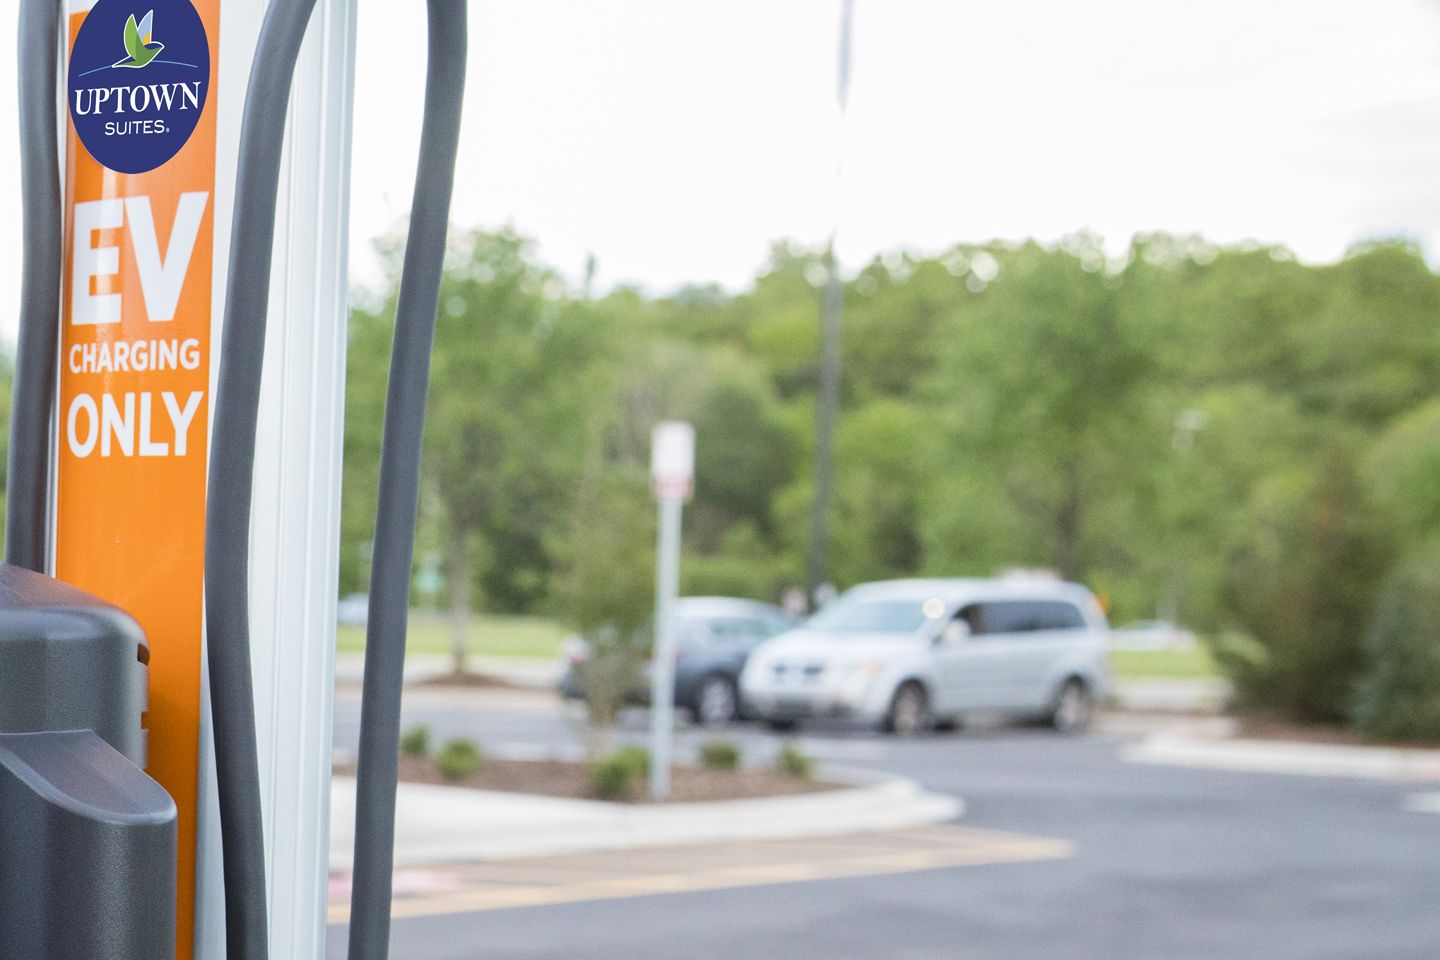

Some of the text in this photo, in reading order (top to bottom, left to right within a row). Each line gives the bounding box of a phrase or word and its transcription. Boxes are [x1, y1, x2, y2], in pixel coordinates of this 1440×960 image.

[75, 82, 201, 115] UPTOWN
[71, 191, 209, 325] EV
[70, 338, 200, 373] CHARGING
[67, 391, 204, 458] ONLY
